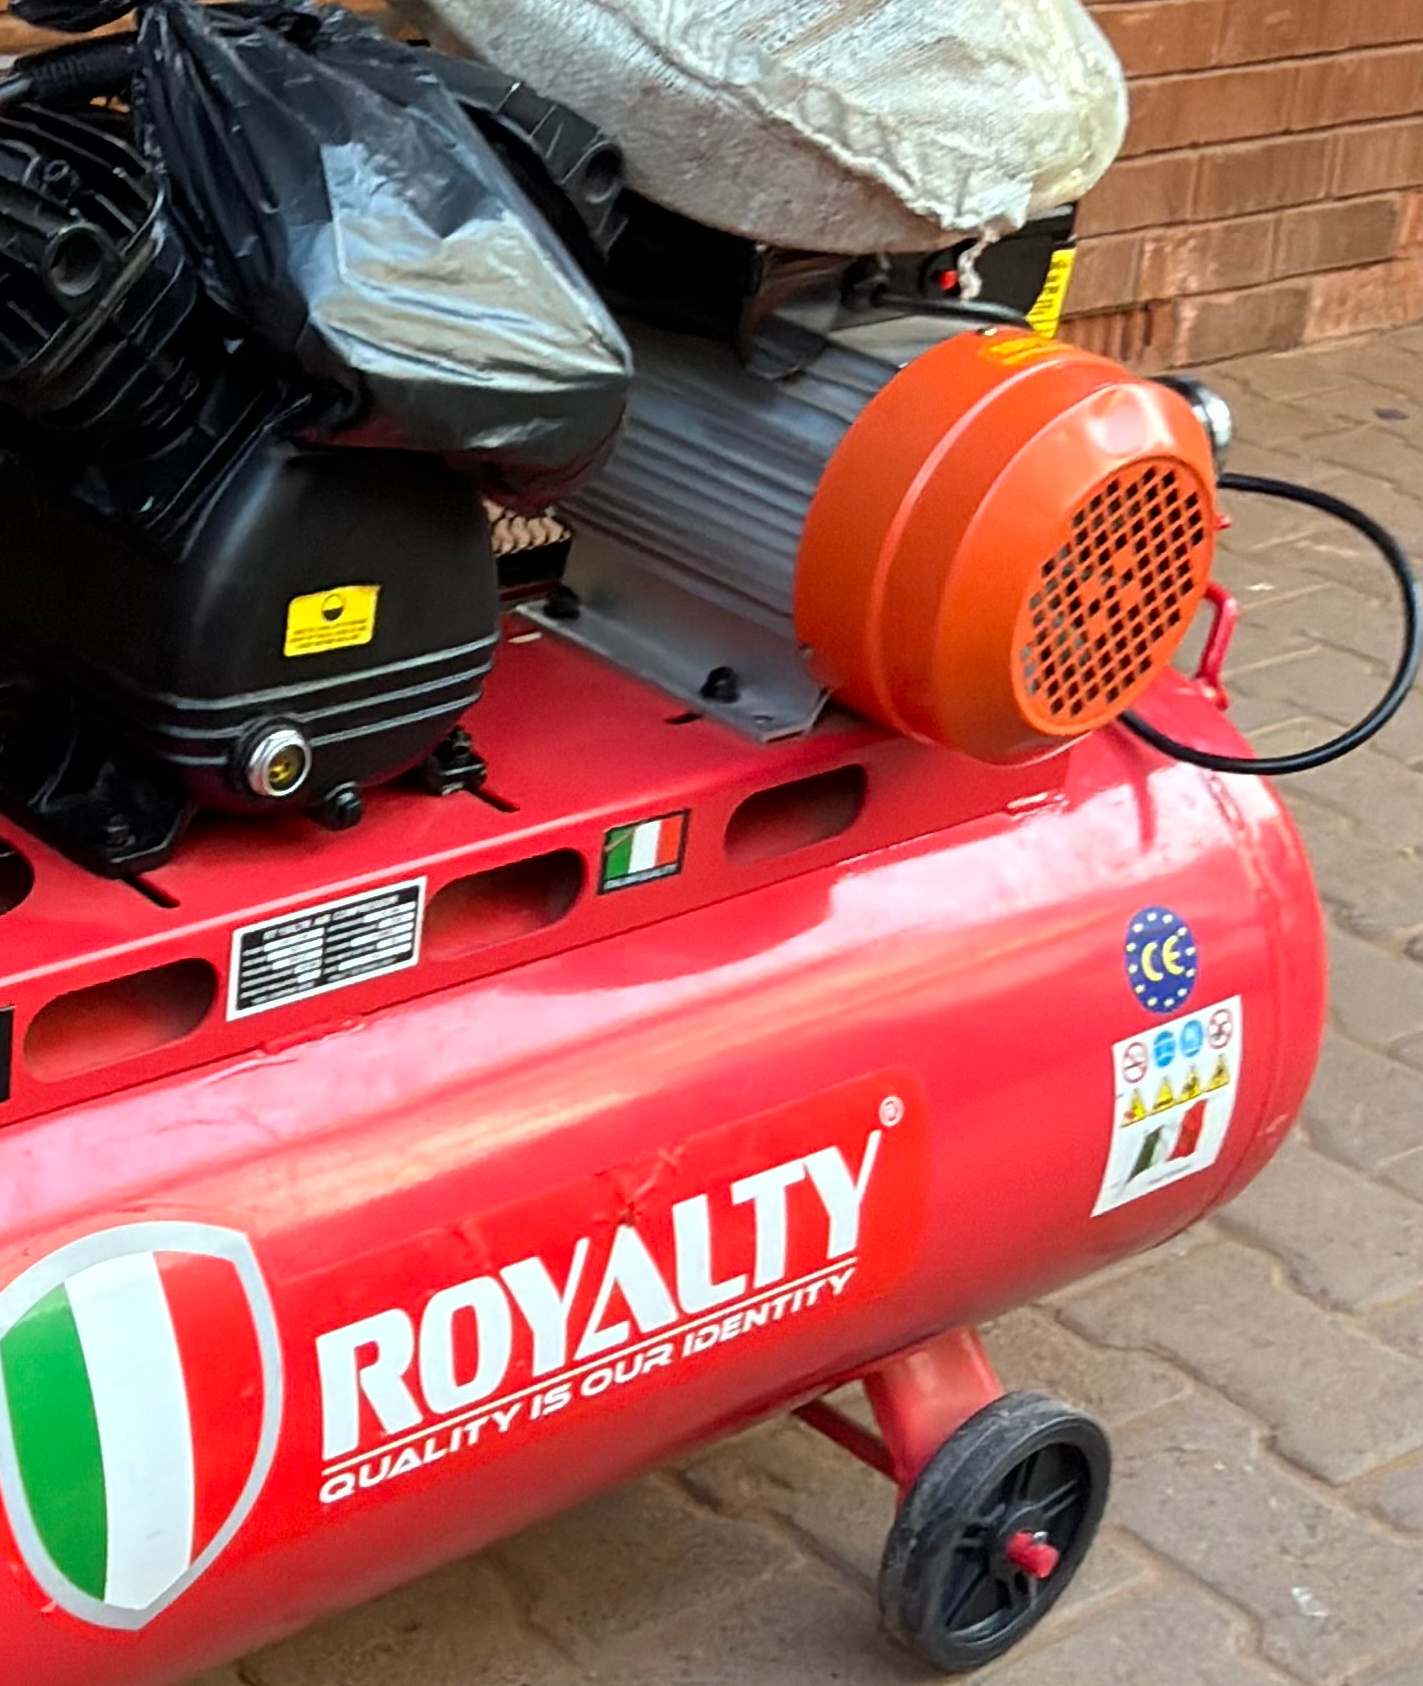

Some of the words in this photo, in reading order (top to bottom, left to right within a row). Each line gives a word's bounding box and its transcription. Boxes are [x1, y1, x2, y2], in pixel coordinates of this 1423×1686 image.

[315, 1128, 882, 1462] ROYALTY
[318, 1405, 522, 1505] QUALITY
[530, 1382, 573, 1421] IS
[579, 1344, 674, 1398] OUR
[680, 1266, 858, 1361] IDENTITY
